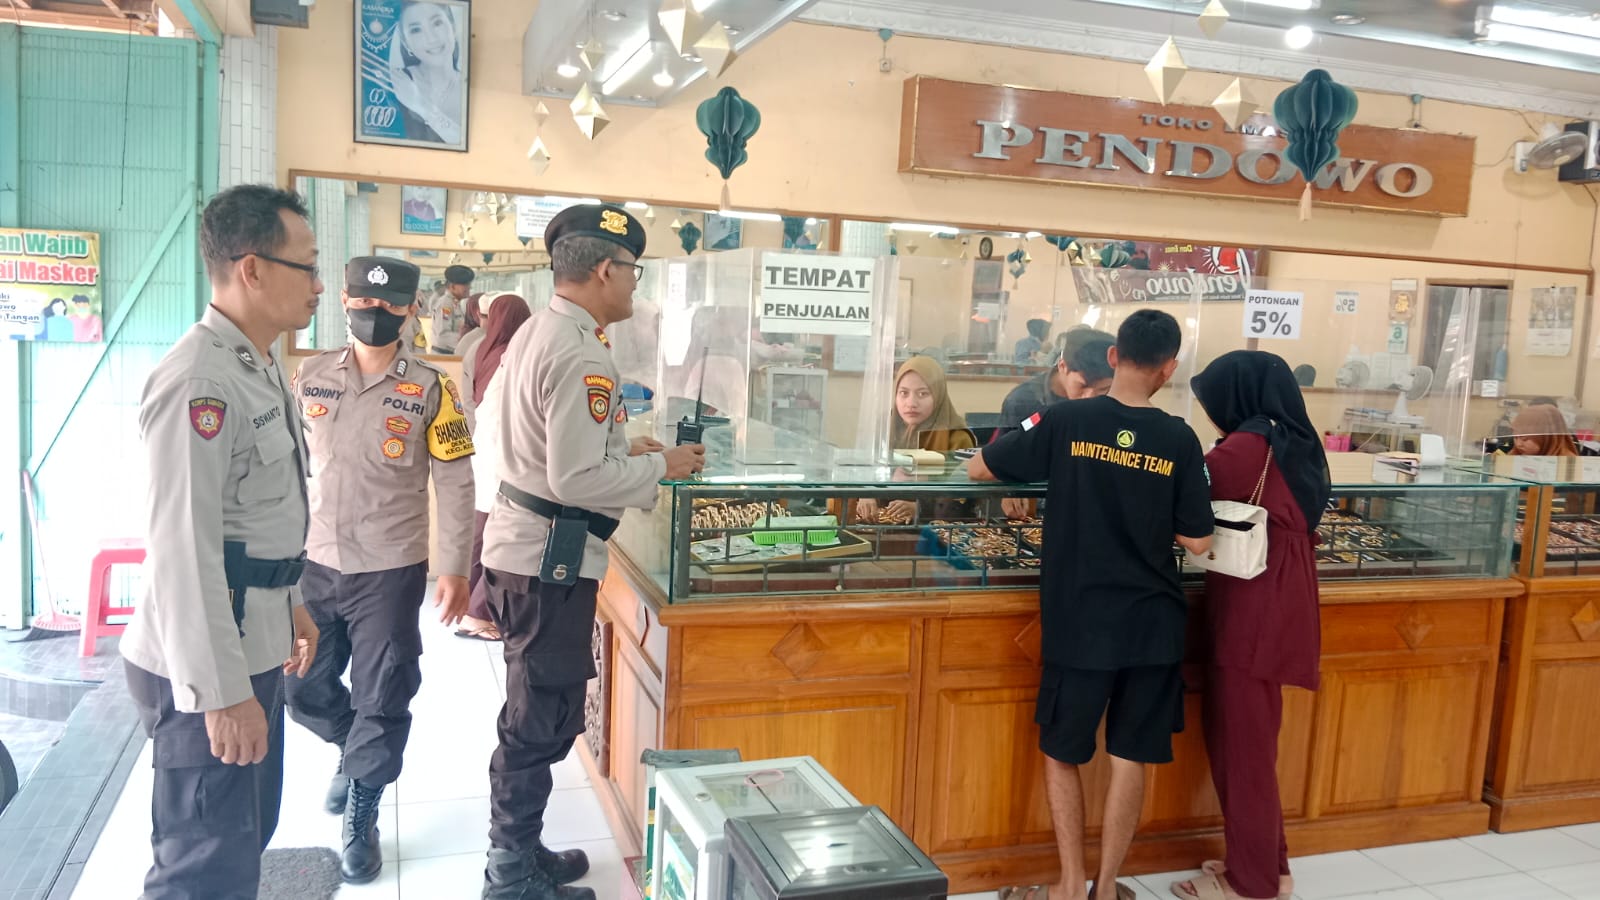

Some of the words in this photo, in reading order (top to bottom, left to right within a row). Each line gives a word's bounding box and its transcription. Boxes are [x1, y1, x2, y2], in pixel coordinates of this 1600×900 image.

[1141, 114, 1213, 129] TOKO
[973, 120, 1434, 198] PENDOWO
[25, 233, 87, 256] Wajib
[19, 261, 96, 283] Masker
[765, 265, 871, 289] TEMPAT
[764, 303, 870, 319] PENJUALAN
[1248, 295, 1299, 306] POTONGAN
[1250, 310, 1292, 336] 5%
[382, 396, 425, 416] POLRI
[1071, 441, 1142, 469] MAINTENANCE
[1143, 455, 1174, 477] TEAM
